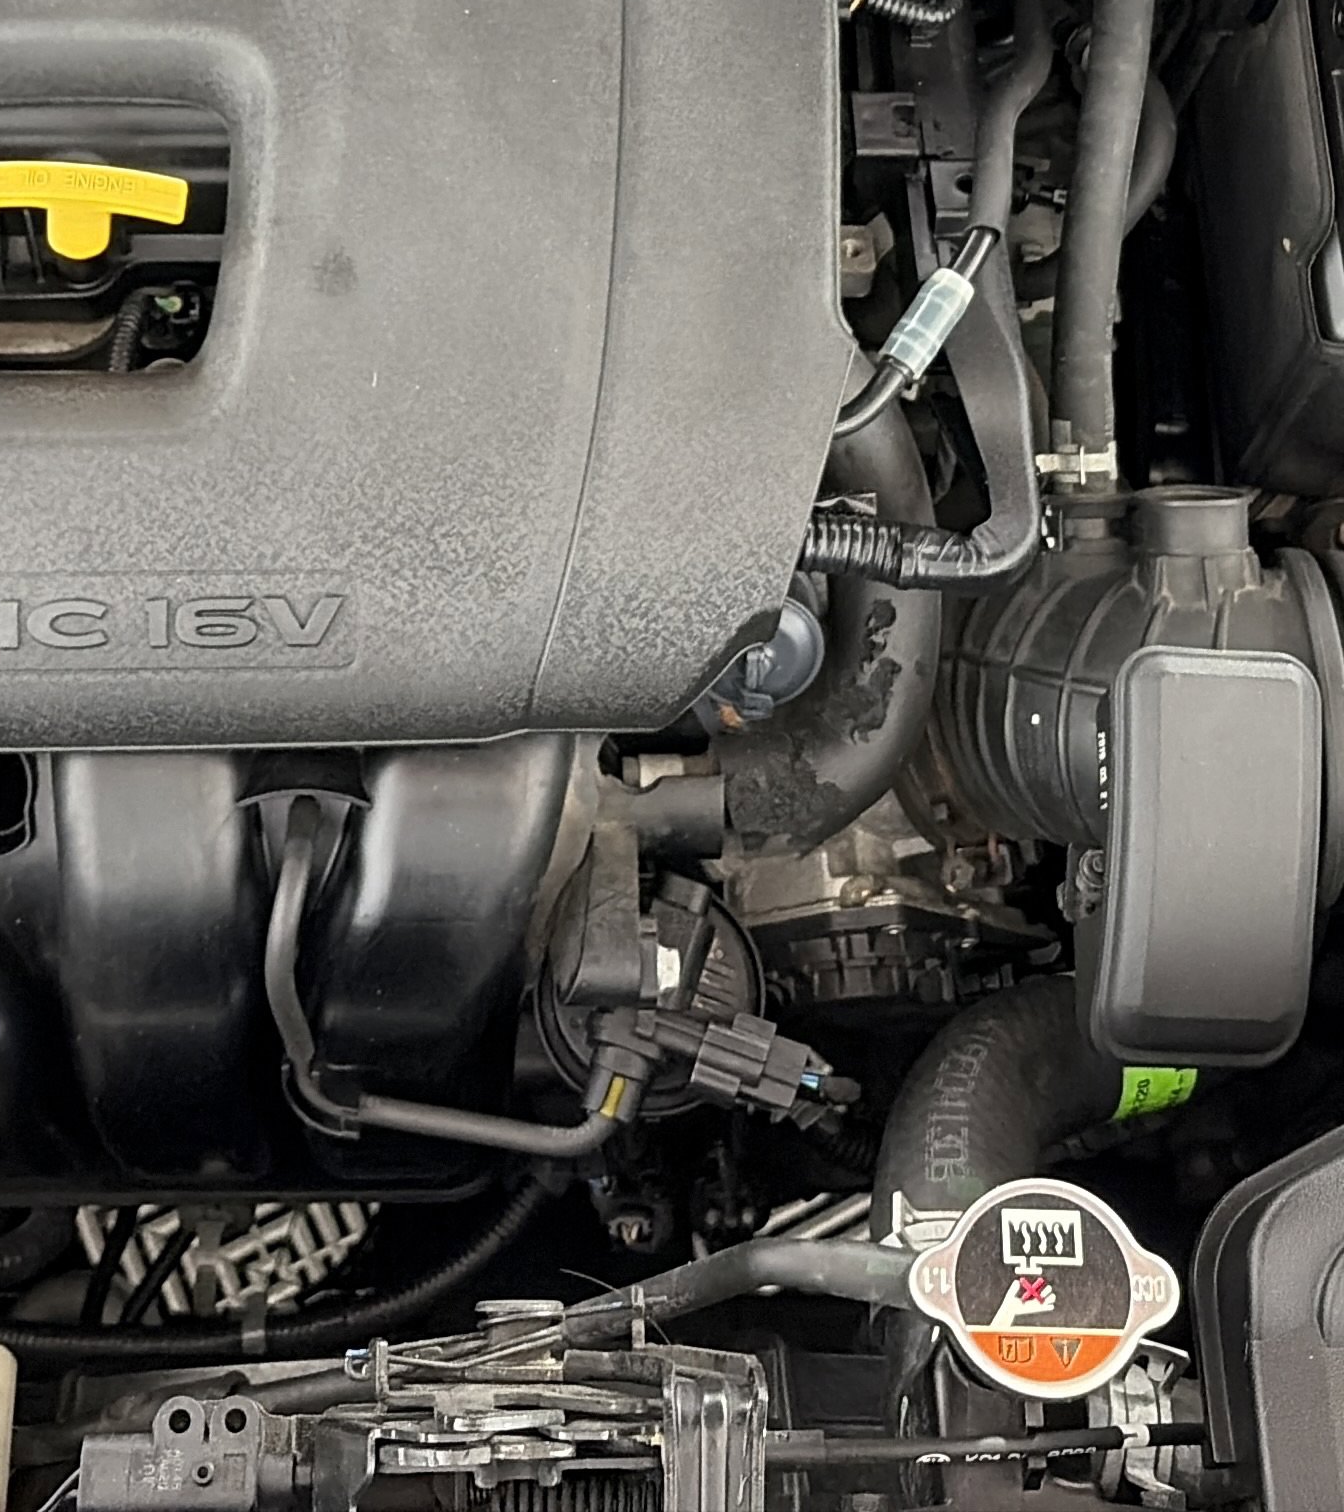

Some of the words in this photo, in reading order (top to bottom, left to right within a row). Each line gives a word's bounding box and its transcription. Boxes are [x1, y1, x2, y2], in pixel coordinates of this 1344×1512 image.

[19, 170, 50, 187] OIL
[66, 171, 136, 193] ENGINE
[144, 595, 346, 650] 16V
[922, 1266, 952, 1295] 1.1
